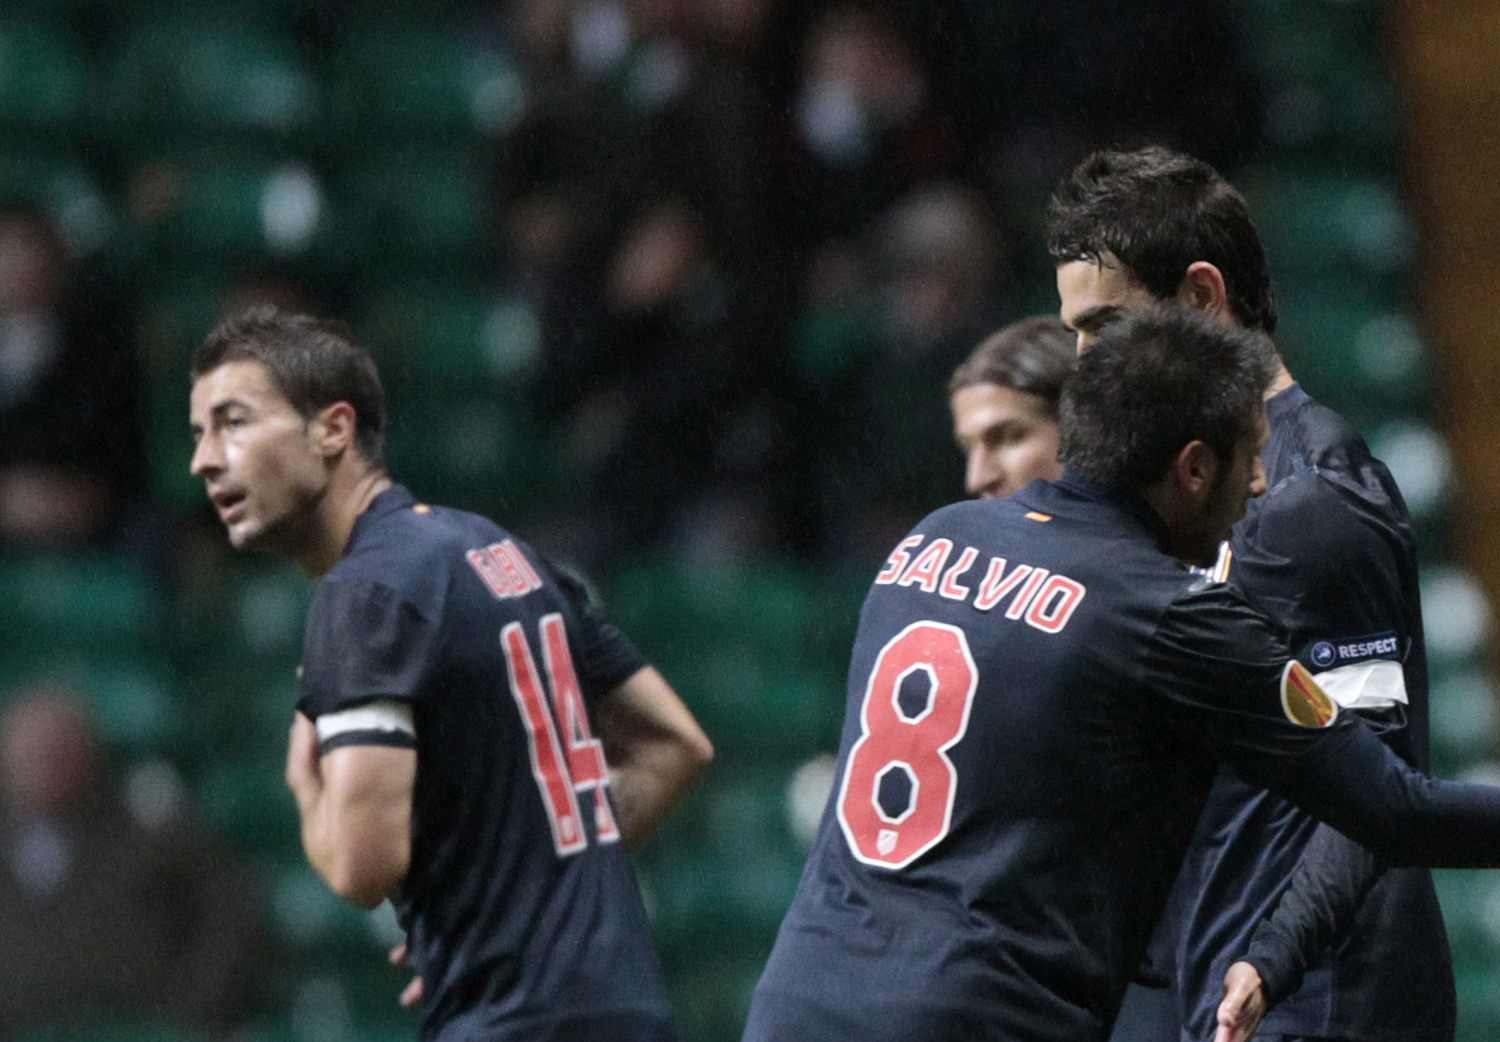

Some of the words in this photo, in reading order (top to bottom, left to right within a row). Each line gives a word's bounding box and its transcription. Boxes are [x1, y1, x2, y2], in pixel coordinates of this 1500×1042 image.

[875, 534, 1086, 634] SALVIO
[1338, 637, 1397, 658] RESPECT
[501, 612, 620, 856] 14
[836, 620, 979, 870] 8
